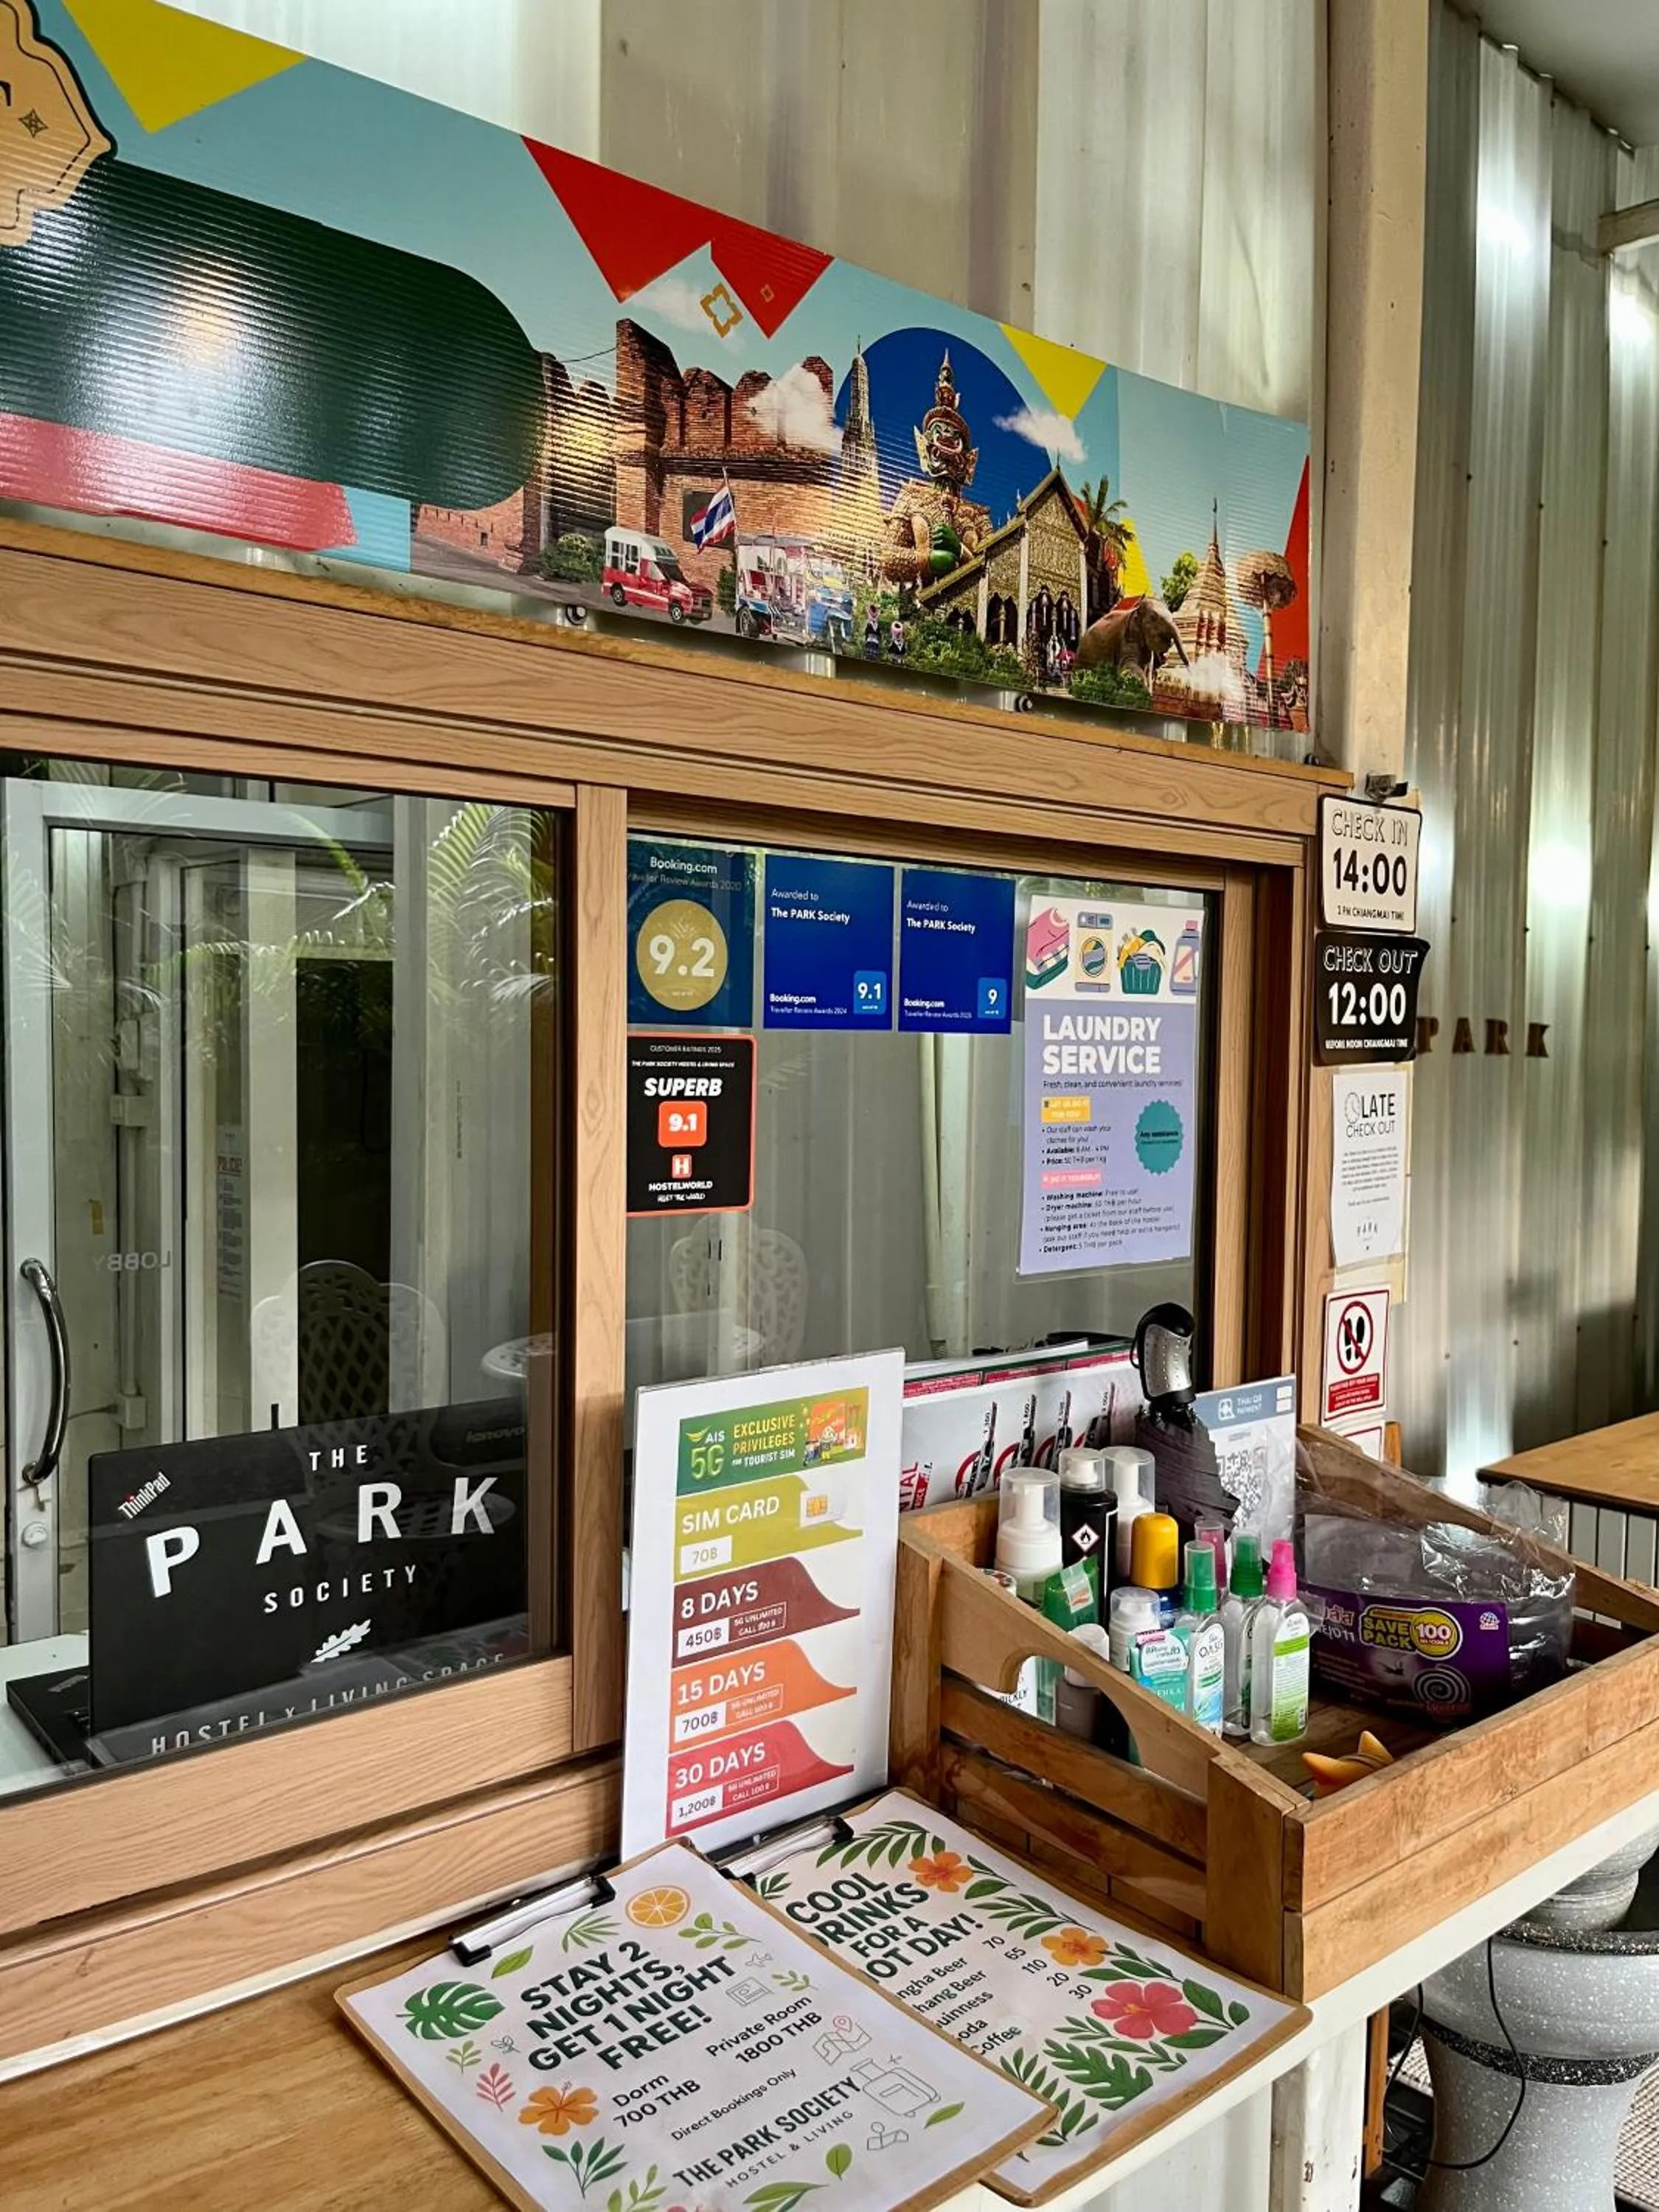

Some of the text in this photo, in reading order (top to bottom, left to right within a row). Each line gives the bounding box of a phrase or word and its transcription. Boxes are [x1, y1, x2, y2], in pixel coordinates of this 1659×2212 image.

[1332, 810, 1408, 846] CHECK IN
[650, 857, 717, 874] Booking.com
[1333, 847, 1408, 897] 14:00
[771, 888, 819, 902] Awarded to
[907, 900, 949, 912] Awarded to
[771, 908, 850, 925] The PARK Society
[907, 917, 975, 934] The PARK Society
[650, 934, 714, 977] 9.2
[1324, 945, 1418, 974] CHECK OUT
[770, 993, 816, 1005] Booking.com
[858, 982, 881, 1000] 9.1
[904, 998, 945, 1009] Booking.com
[988, 990, 997, 1005] 9
[1328, 981, 1406, 1026] 12:00
[1043, 1015, 1162, 1041] LAUNDRY
[1416, 1016, 1550, 1058] PARK
[1043, 1045, 1162, 1074] SERVICE
[644, 1077, 723, 1096] SUPERB
[1360, 1093, 1396, 1119] LATE
[669, 1113, 698, 1132] 9.1
[1346, 1119, 1396, 1138] CHECK OUT
[675, 1158, 689, 1175] H
[648, 1180, 713, 1192] HOSTELWORLD
[1046, 1192, 1074, 1201] Washing
[705, 1430, 725, 1444] AIS
[733, 1414, 796, 1439] EXCLUSIVE
[309, 1444, 369, 1472] THE
[732, 1432, 796, 1455] PRIVILEGES
[744, 1451, 778, 1467] TOURIST
[779, 1448, 796, 1461] SIM
[690, 1444, 725, 1480] 5G
[118, 1471, 171, 1519] ThinkPad
[681, 1496, 779, 1534] SIM CARD
[147, 1476, 499, 1598] PARK
[263, 1565, 418, 1614] SOCIETY
[681, 1581, 759, 1619] 8 DAYS
[745, 1607, 783, 1623] UNLIMITED
[1364, 1617, 1409, 1635] SAVE
[738, 1626, 757, 1636] CALL
[1364, 1630, 1413, 1649] PACK
[1416, 1624, 1451, 1640] 100
[678, 1662, 766, 1705] 15 DAYS
[675, 1742, 766, 1789] 30 DAYS
[733, 1790, 749, 1801] CALL
[785, 1871, 888, 1924] COOL
[849, 1915, 930, 1958] FOR A
[858, 1913, 984, 1983] OT DAY!
[520, 1941, 650, 2011] STAY 2
[897, 1935, 1006, 2000] ngha Beer 70
[913, 1945, 1026, 2014] hang Beer 65
[526, 1959, 685, 2040] NIGHTS,
[935, 1958, 1048, 2028] uinness 110
[957, 1972, 1070, 2041] oda 20
[1068, 1984, 1093, 2000] 30
[528, 1955, 736, 2071] GET 1 NIGHT
[705, 1996, 813, 2058] Private Room
[597, 2003, 713, 2070] FREE!
[735, 2012, 823, 2064] 1800 THB
[612, 2073, 669, 2107] Dorm
[614, 2079, 701, 2129] 700 THB
[671, 2067, 797, 2140] Direct Bookings Only
[672, 2076, 862, 2188] THE PARK SOCIETY
[725, 2110, 855, 2188] HOSTEL & LIVING
